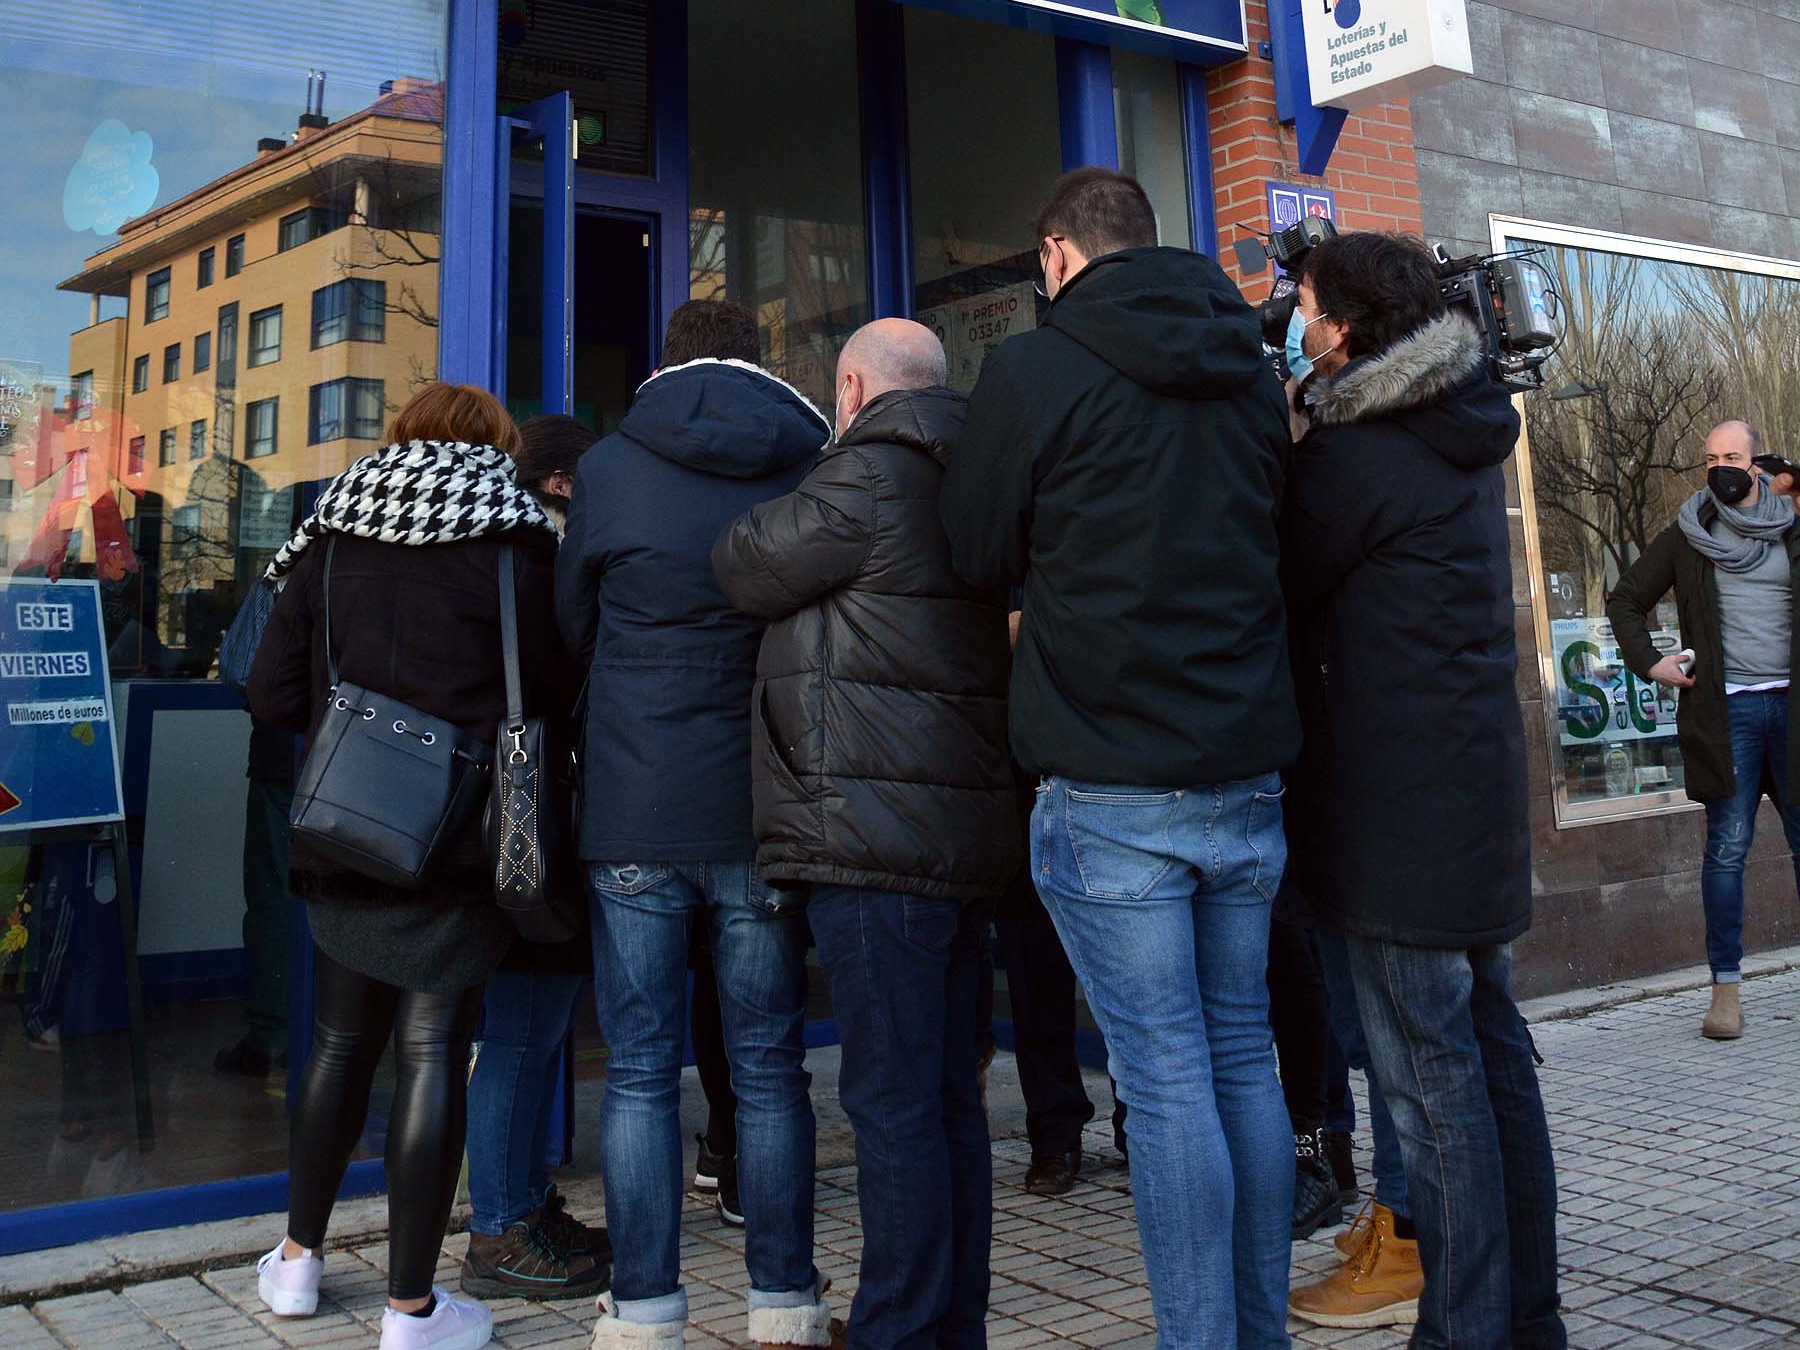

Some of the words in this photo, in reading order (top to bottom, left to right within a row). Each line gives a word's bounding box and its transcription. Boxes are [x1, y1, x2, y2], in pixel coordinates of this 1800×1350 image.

[1327, 26, 1376, 51] Loterías
[1379, 21, 1386, 36] y
[1330, 40, 1385, 68] Apuestas
[1389, 29, 1408, 47] del
[1331, 61, 1373, 84] Estado
[974, 297, 1018, 323] PREMIO
[968, 317, 1011, 342] 03347
[19, 605, 70, 628] ESTE
[1, 654, 88, 675] VIERNES
[11, 707, 55, 723] Millones
[58, 705, 72, 720] de
[74, 706, 104, 719] euros
